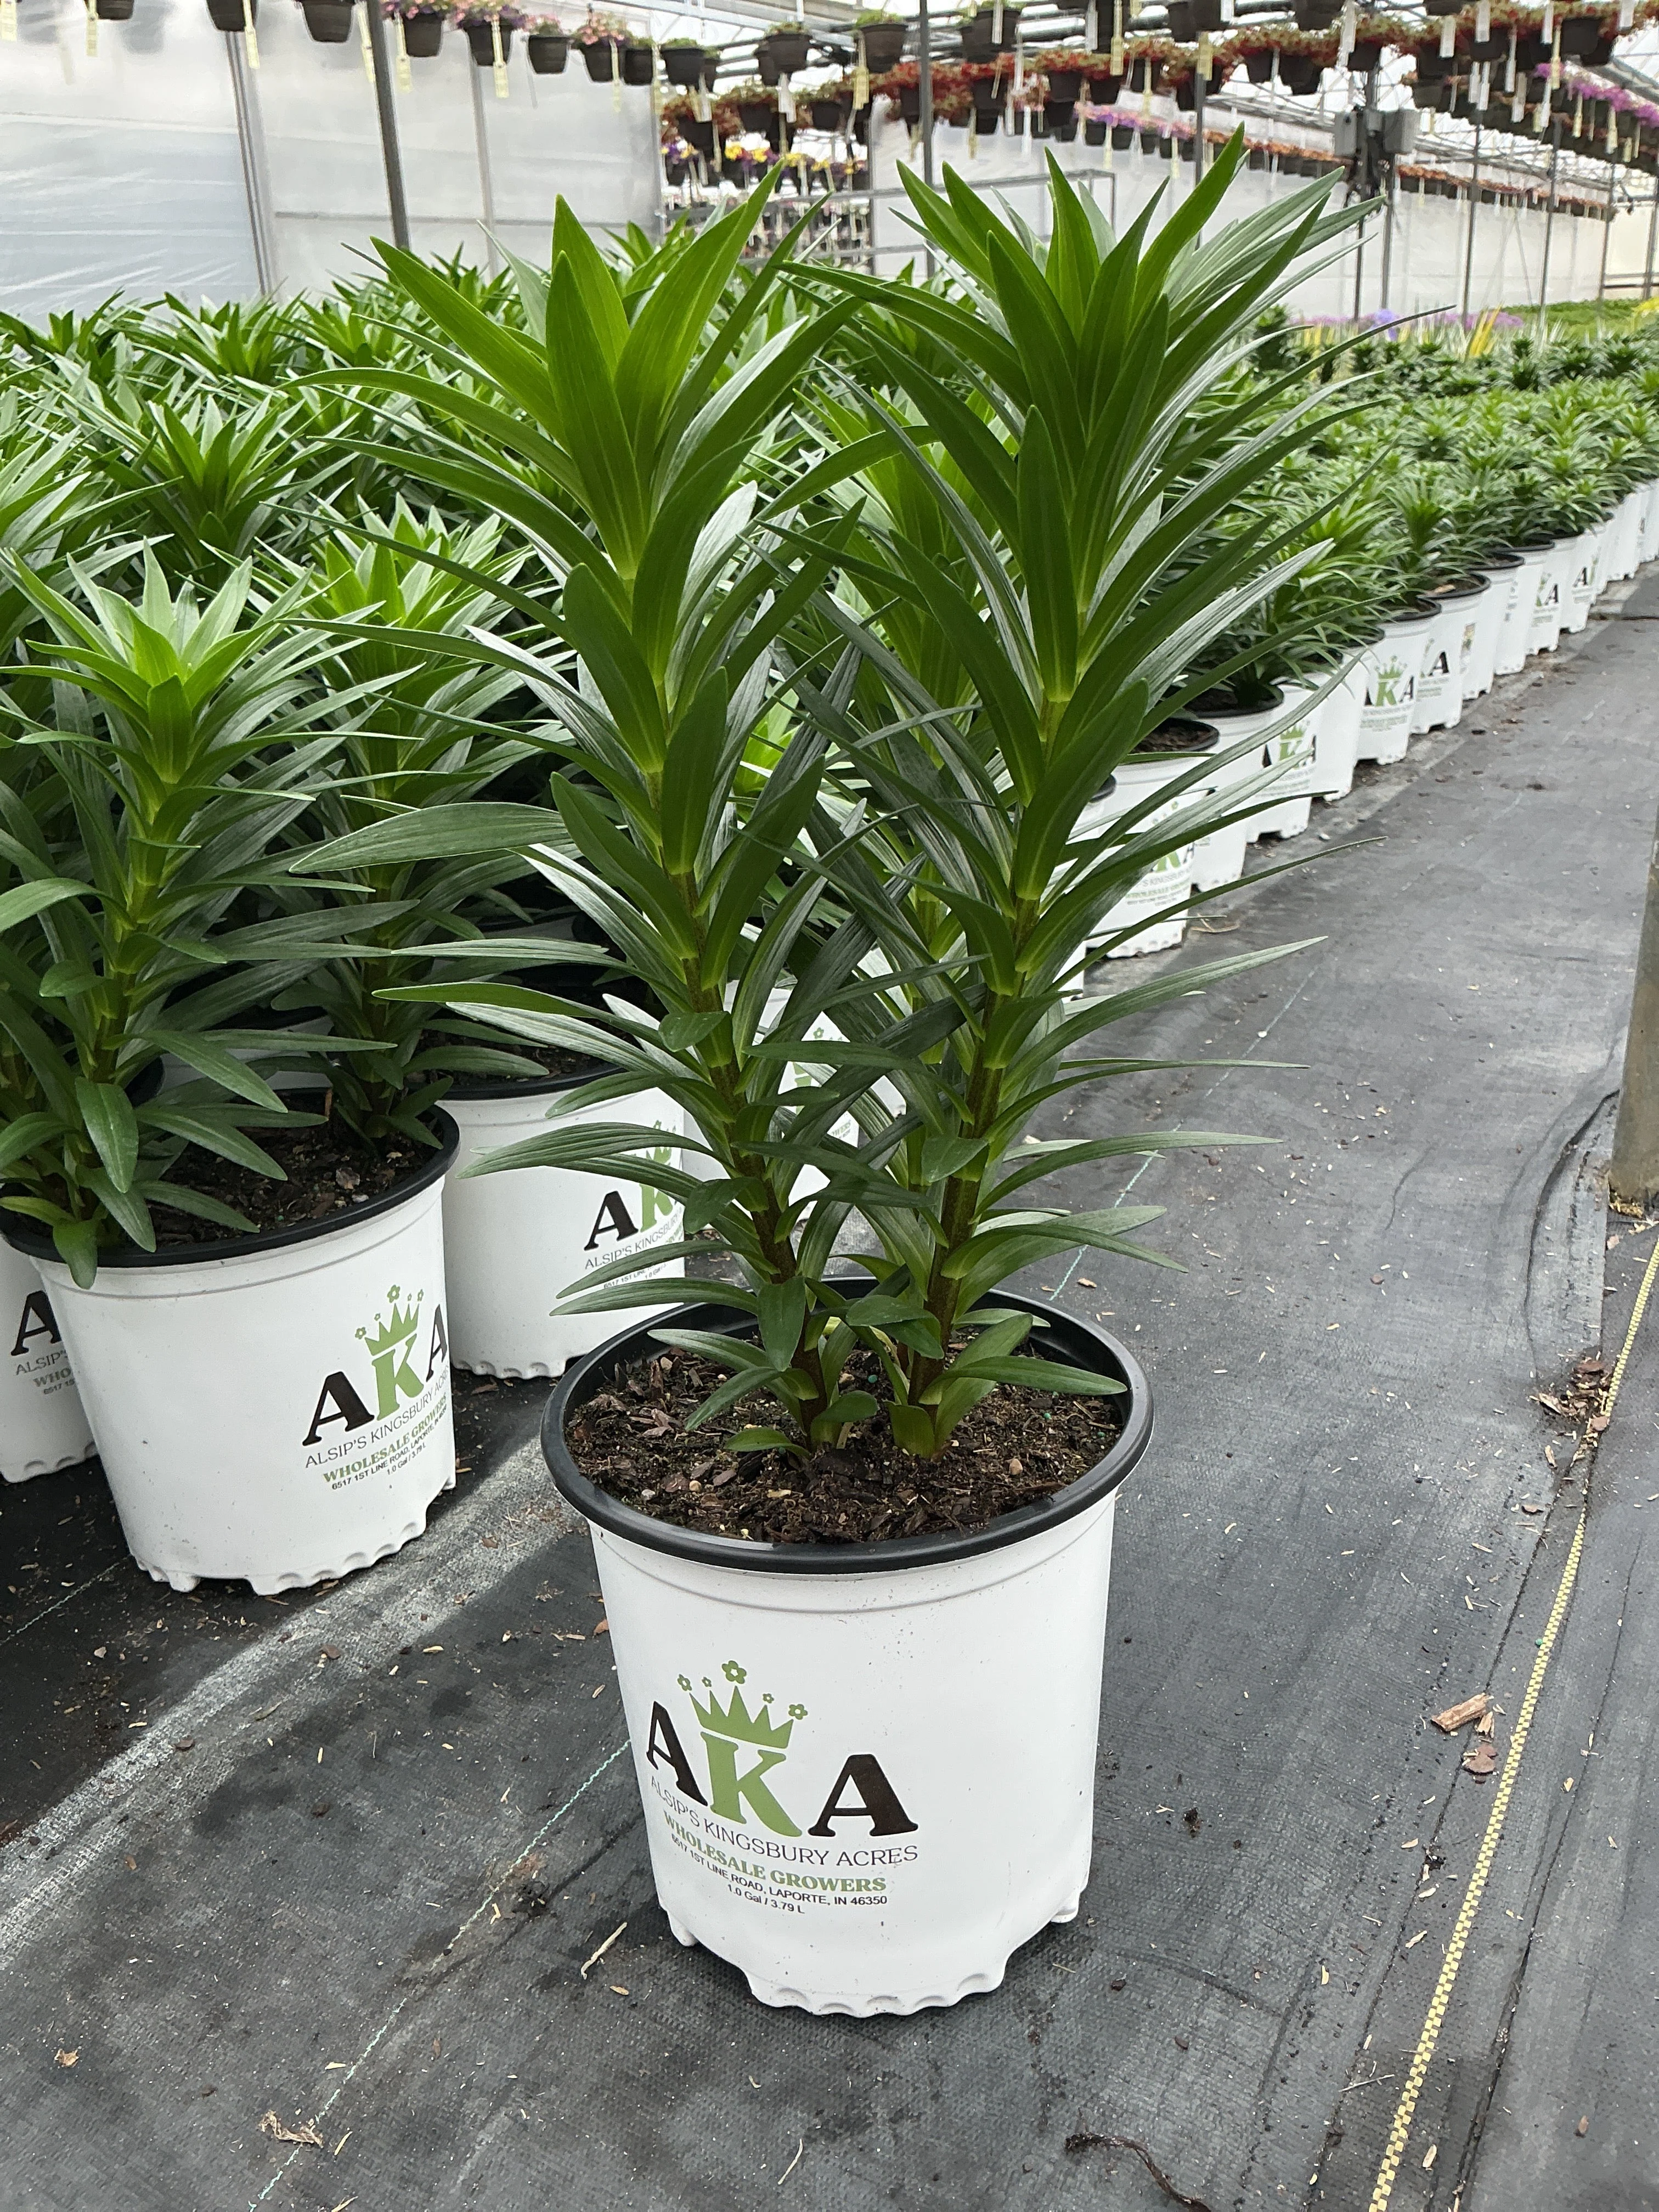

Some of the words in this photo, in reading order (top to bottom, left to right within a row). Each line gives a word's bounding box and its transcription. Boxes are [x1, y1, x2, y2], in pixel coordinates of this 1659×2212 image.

[302, 1304, 448, 1447] AKA
[305, 1435, 367, 1469] ALSIP'S
[371, 1387, 433, 1443] KINGSBURY
[323, 1432, 410, 1483] WHOLESALE
[354, 1469, 370, 1481] 1ST
[371, 1459, 388, 1475] LINE
[646, 1701, 918, 1837] AKA
[651, 1775, 700, 1827] ALSIP'S
[703, 1818, 829, 1865] KINGSBURY
[836, 1845, 918, 1866] ACRES
[663, 1810, 766, 1880] WHOLESALE
[770, 1870, 887, 1892] GROWERS
[690, 1849, 705, 1866] 1ST
[707, 1860, 729, 1880] LINE
[769, 1886, 831, 1906] LAPORTE,
[834, 1896, 847, 1905] IN
[850, 1895, 888, 1905] 46350
[727, 1883, 742, 1896] 1.0
[744, 1891, 762, 1904] Gal
[771, 1899, 794, 1912] 3.79
[798, 1905, 805, 1914] L
